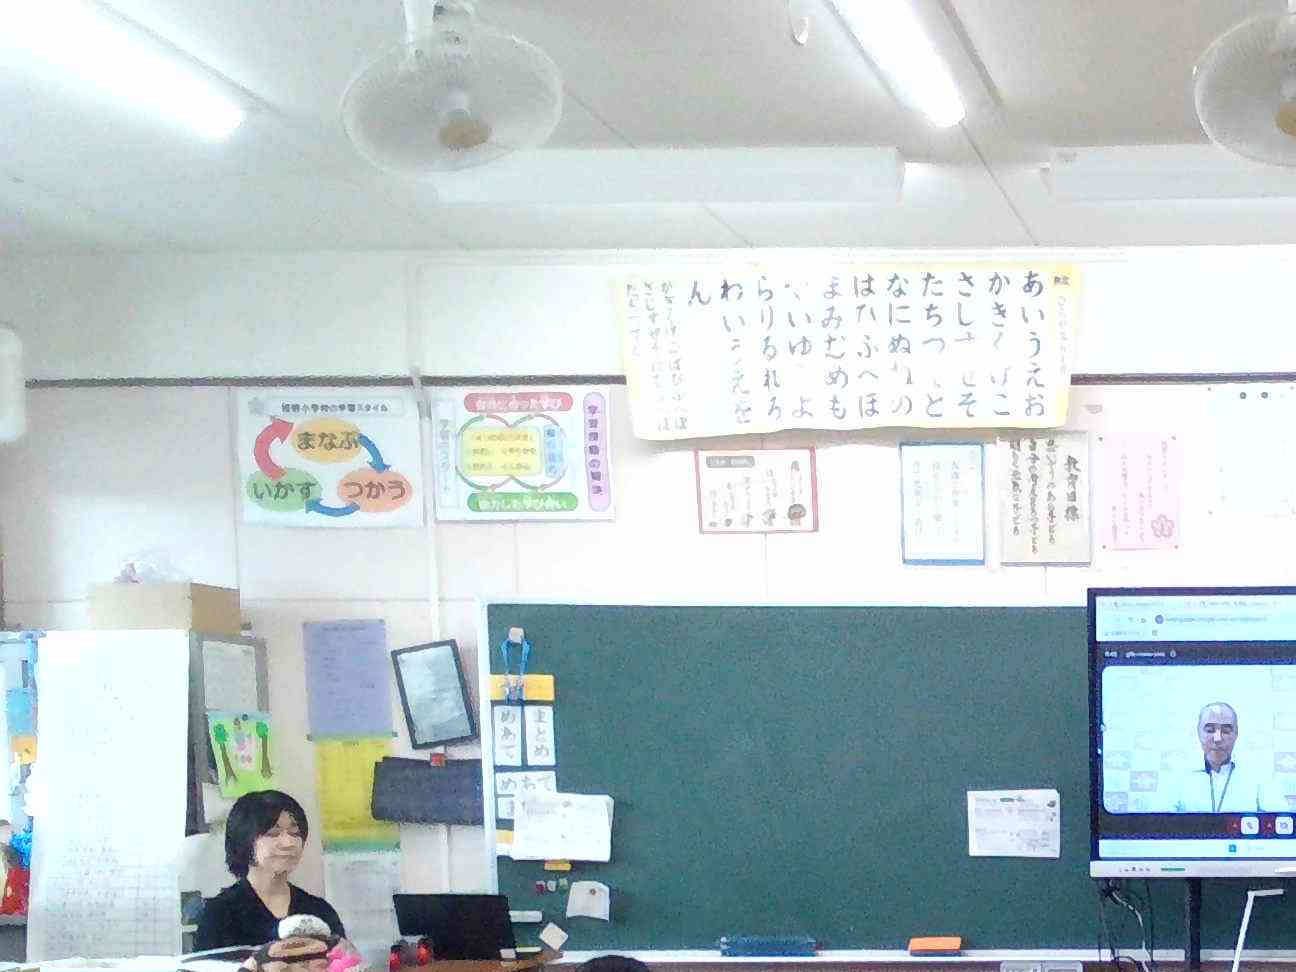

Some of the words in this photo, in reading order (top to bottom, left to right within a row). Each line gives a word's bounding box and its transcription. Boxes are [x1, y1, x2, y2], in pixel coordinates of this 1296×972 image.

[757, 275, 785, 424] らりるれろ
[823, 272, 850, 420] まみむめも
[1021, 270, 1046, 417] あいうえお
[296, 431, 359, 450] まなぶ
[253, 481, 318, 500] いかす
[343, 481, 406, 500] つかう
